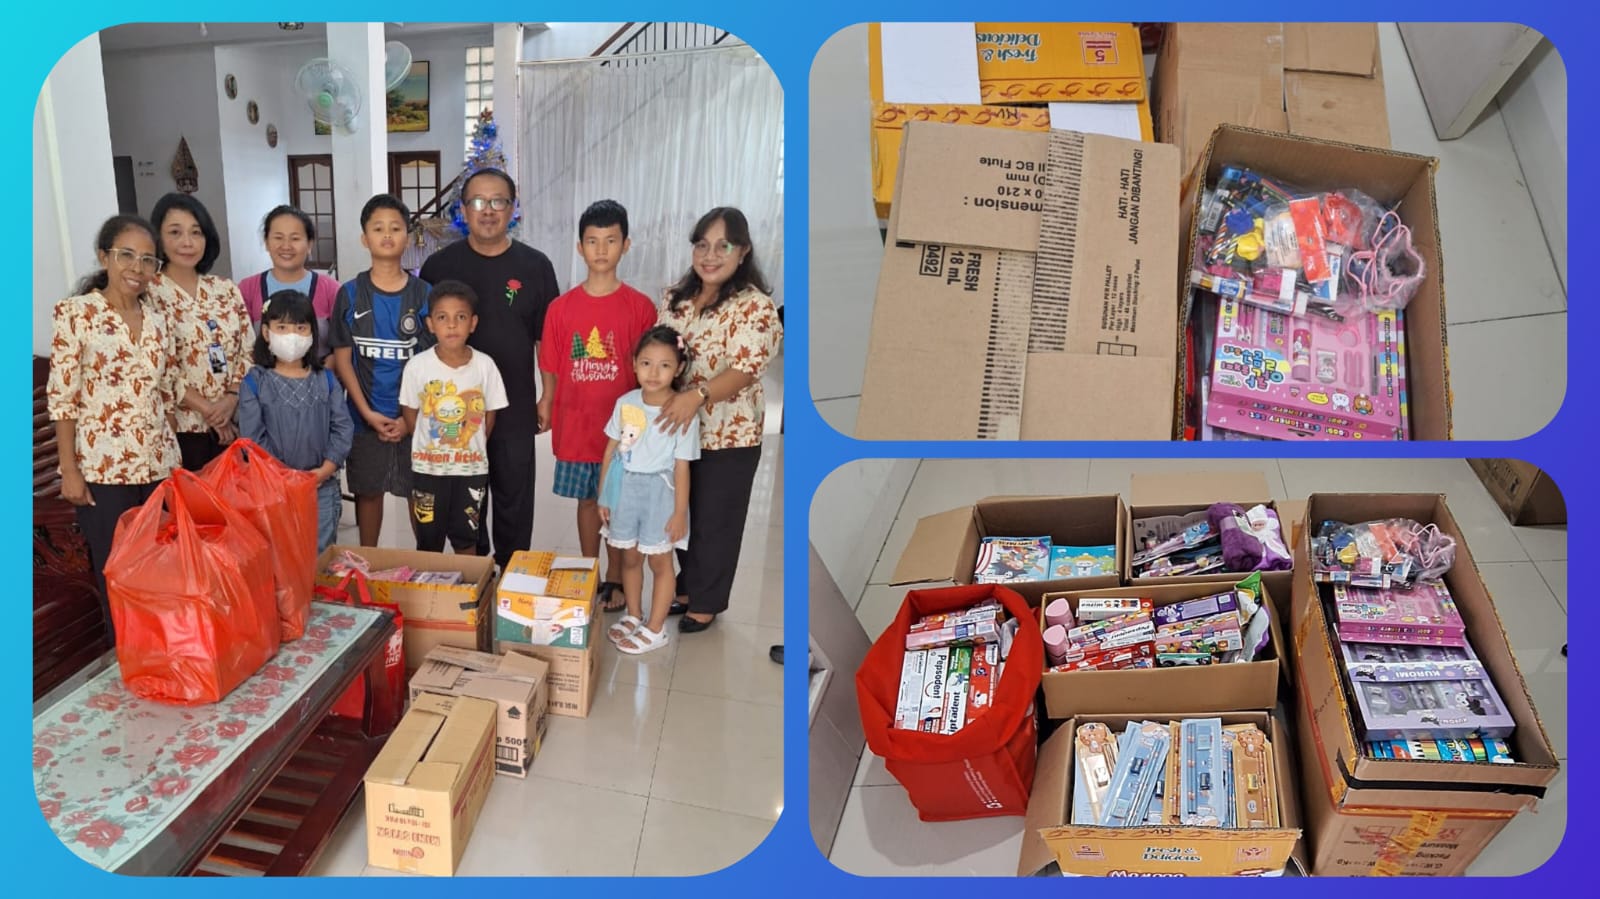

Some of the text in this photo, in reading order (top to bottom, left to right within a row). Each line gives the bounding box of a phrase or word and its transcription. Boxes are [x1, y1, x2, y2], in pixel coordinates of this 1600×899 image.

[976, 32, 1040, 47] Delicious
[996, 48, 1038, 62] Fresh
[1094, 49, 1106, 62] 5
[979, 157, 1012, 169] Flute
[1016, 160, 1035, 171] BC
[1005, 172, 1030, 183] mm
[1121, 168, 1131, 191] HATI
[997, 185, 1020, 196] 210
[1024, 188, 1032, 197] x
[1127, 149, 1145, 245] JANGAN DIBANTING!
[1118, 196, 1128, 219] HATI
[923, 244, 942, 274] 0492
[946, 250, 965, 285] 18 mL
[963, 252, 982, 292] FRESH
[933, 654, 947, 699] Pepsodent
[1395, 670, 1441, 678] KUROMI
[505, 736, 523, 746] 500
